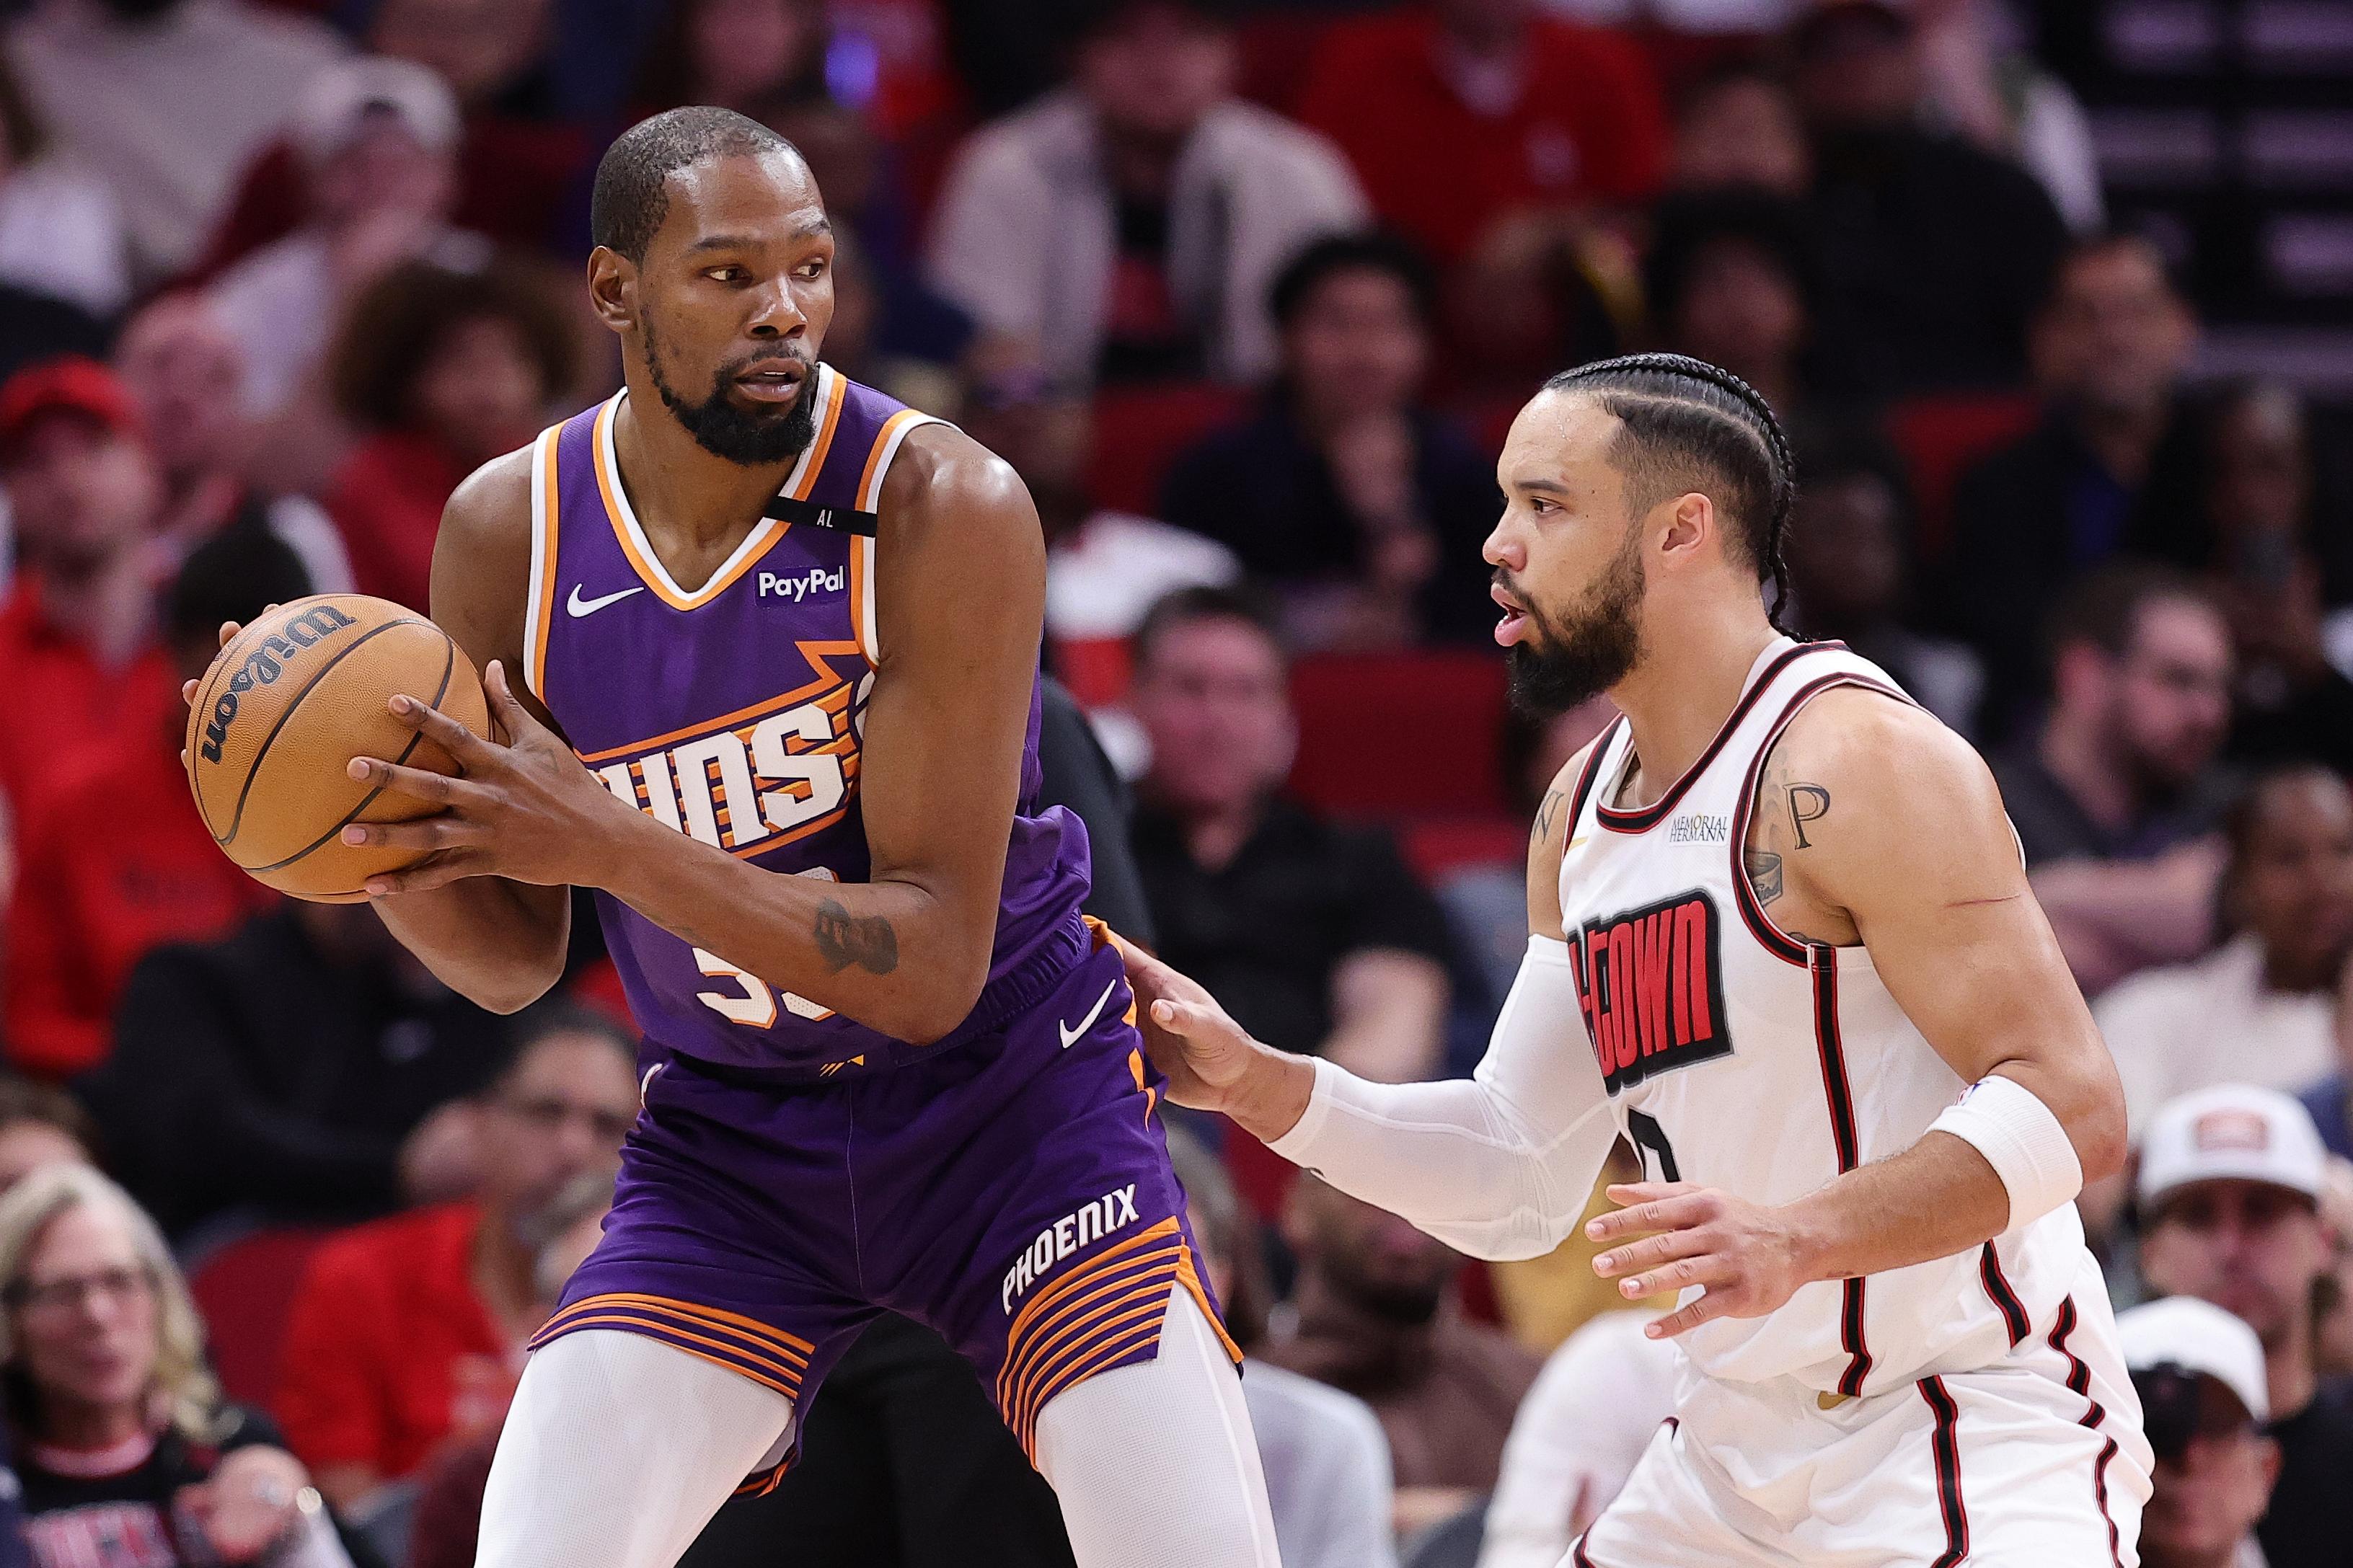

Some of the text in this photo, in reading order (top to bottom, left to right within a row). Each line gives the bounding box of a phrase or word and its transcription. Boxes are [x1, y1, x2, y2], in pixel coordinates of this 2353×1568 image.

[816, 509, 834, 528] AL
[759, 565, 844, 603] PayPal
[201, 605, 358, 765] Wilson
[586, 702, 845, 849] UNS
[1669, 828, 1726, 842] HERMANN
[1672, 815, 1727, 830] MEMORIAL
[1002, 1183, 1140, 1316] PHOENIX
